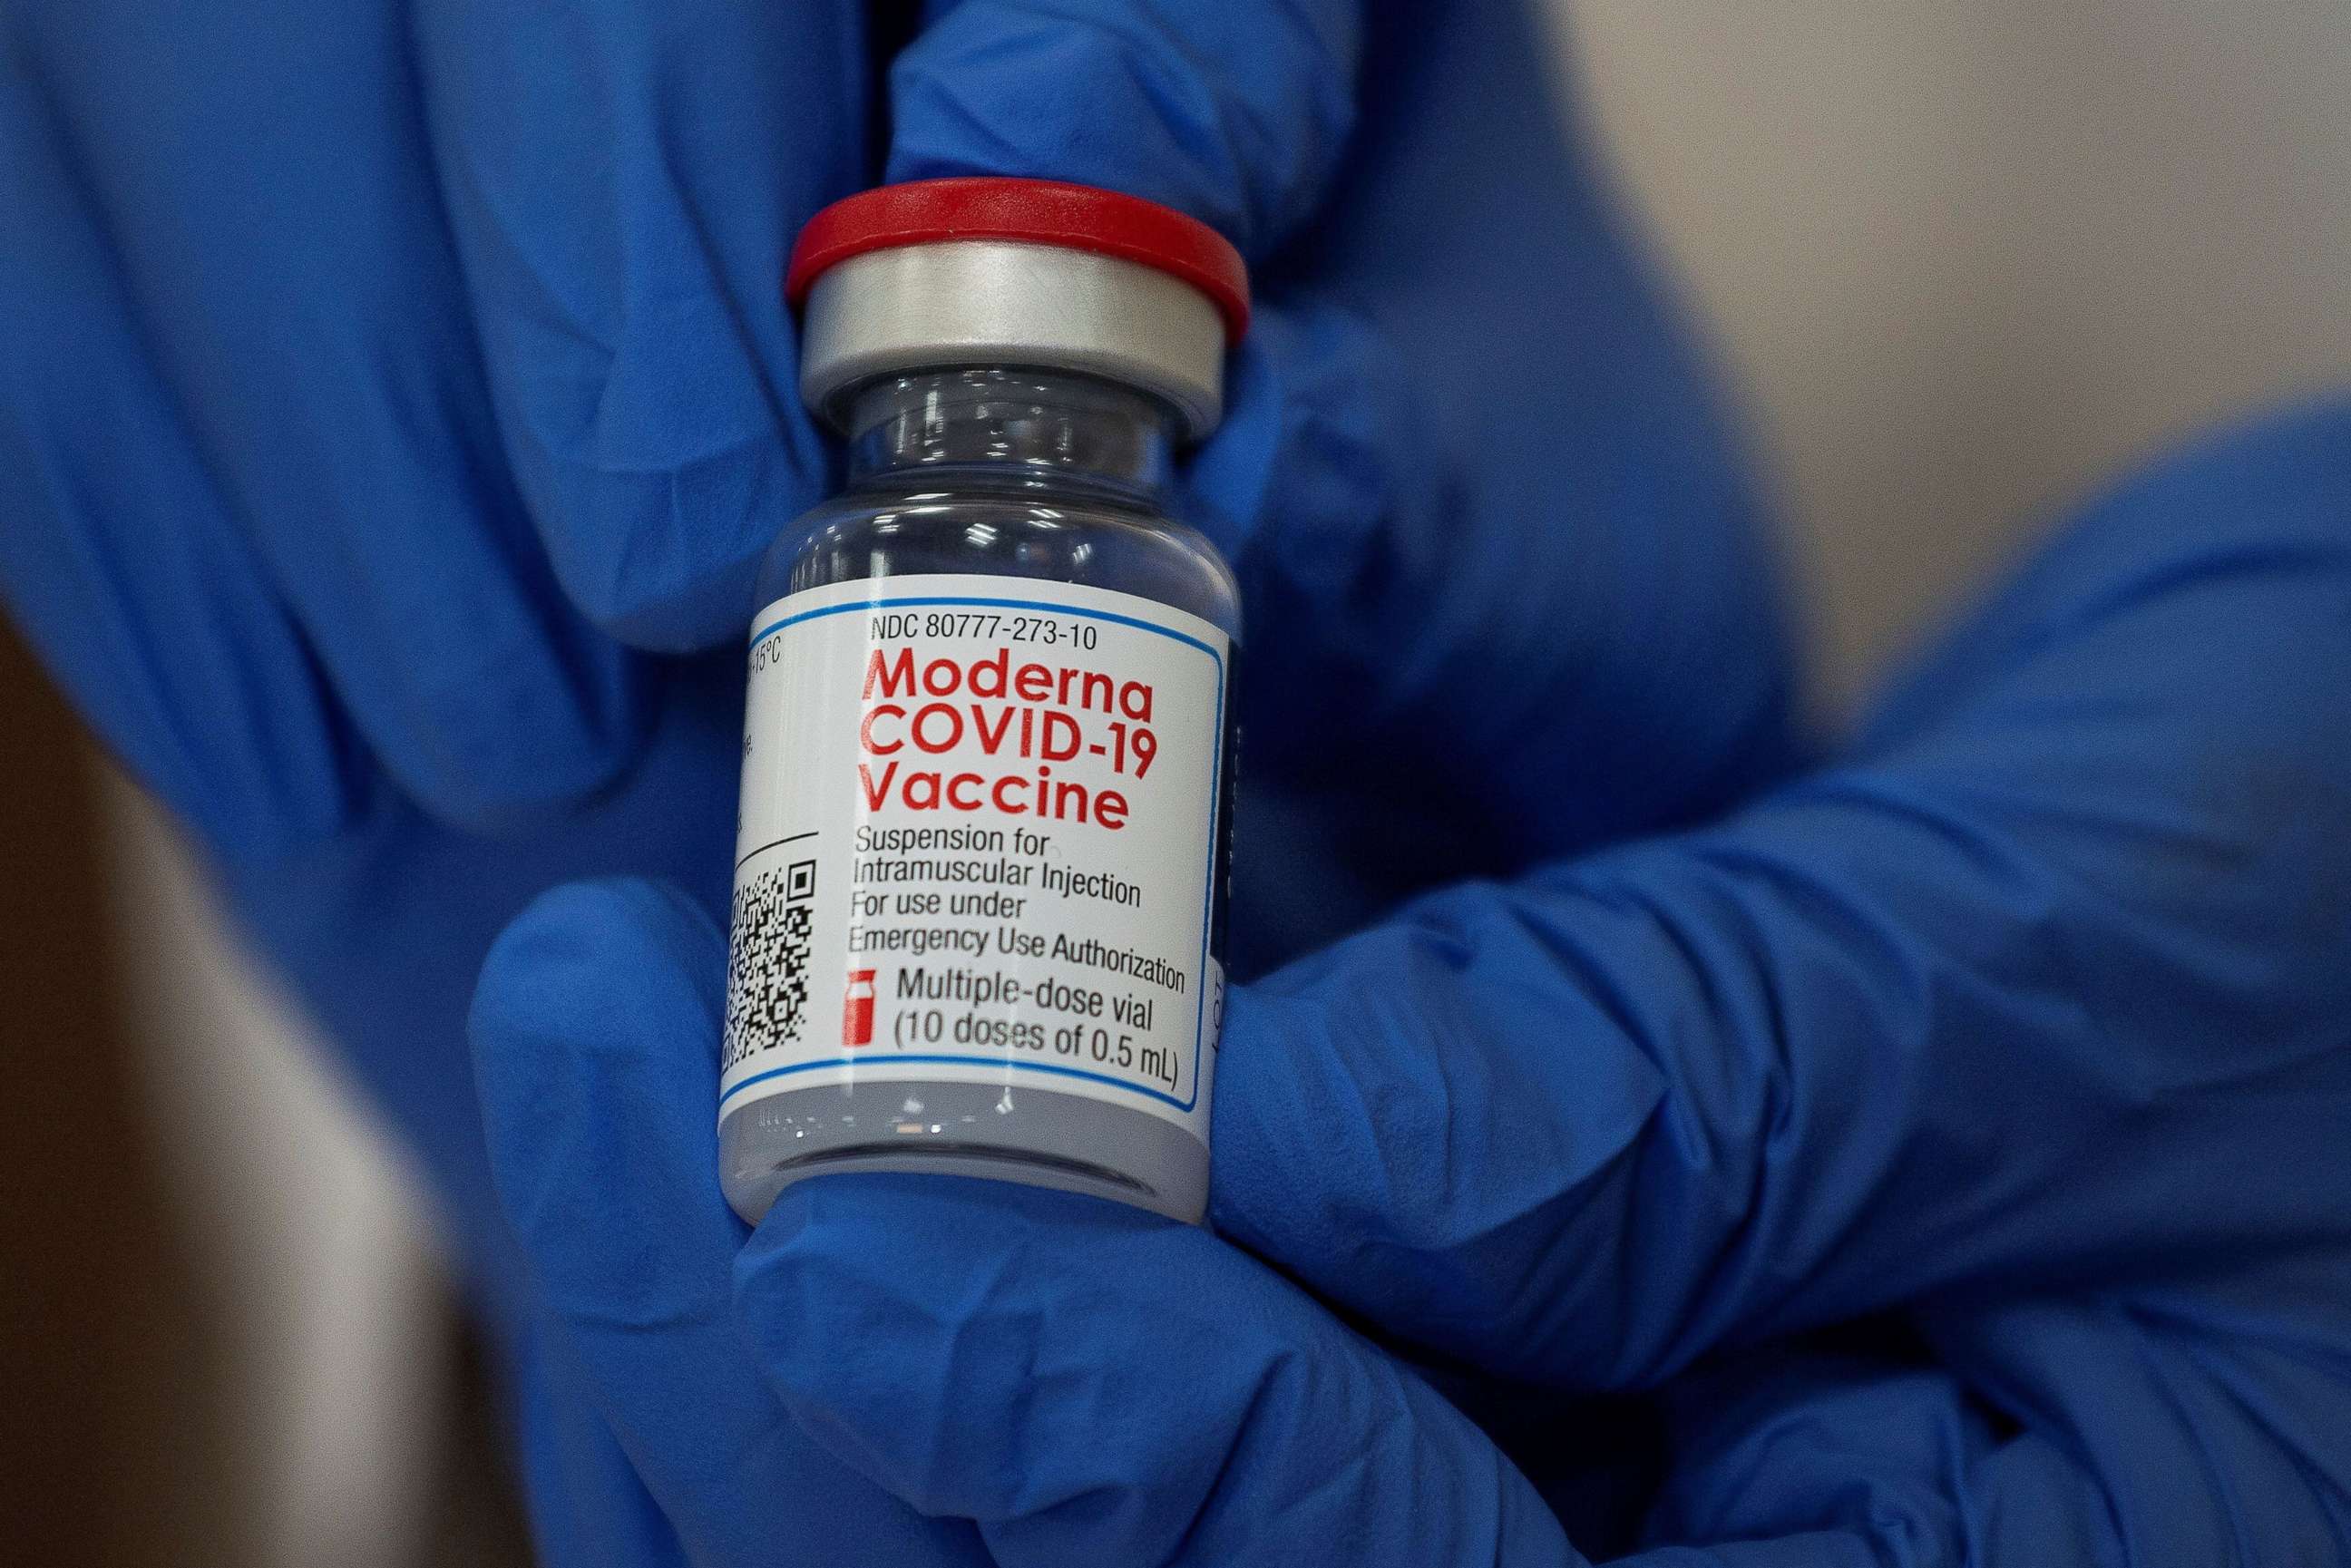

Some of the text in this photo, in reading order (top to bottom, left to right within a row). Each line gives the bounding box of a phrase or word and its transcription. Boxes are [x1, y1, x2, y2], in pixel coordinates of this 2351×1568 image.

[872, 614, 1097, 649] NDC 80777-273-10
[862, 648, 1153, 723] Moderna
[860, 703, 1157, 779] COVID-19
[859, 761, 1128, 830] Vaccine
[856, 823, 1050, 855] Suspension for
[852, 890, 1026, 918] For use under
[854, 858, 1141, 907] Intramuscular Injection
[849, 926, 1185, 994] Emergency Use Authorization
[896, 967, 1153, 1031] Multiple-dose vial
[894, 1008, 1179, 1091] (10 doses of 0.5 mL)
